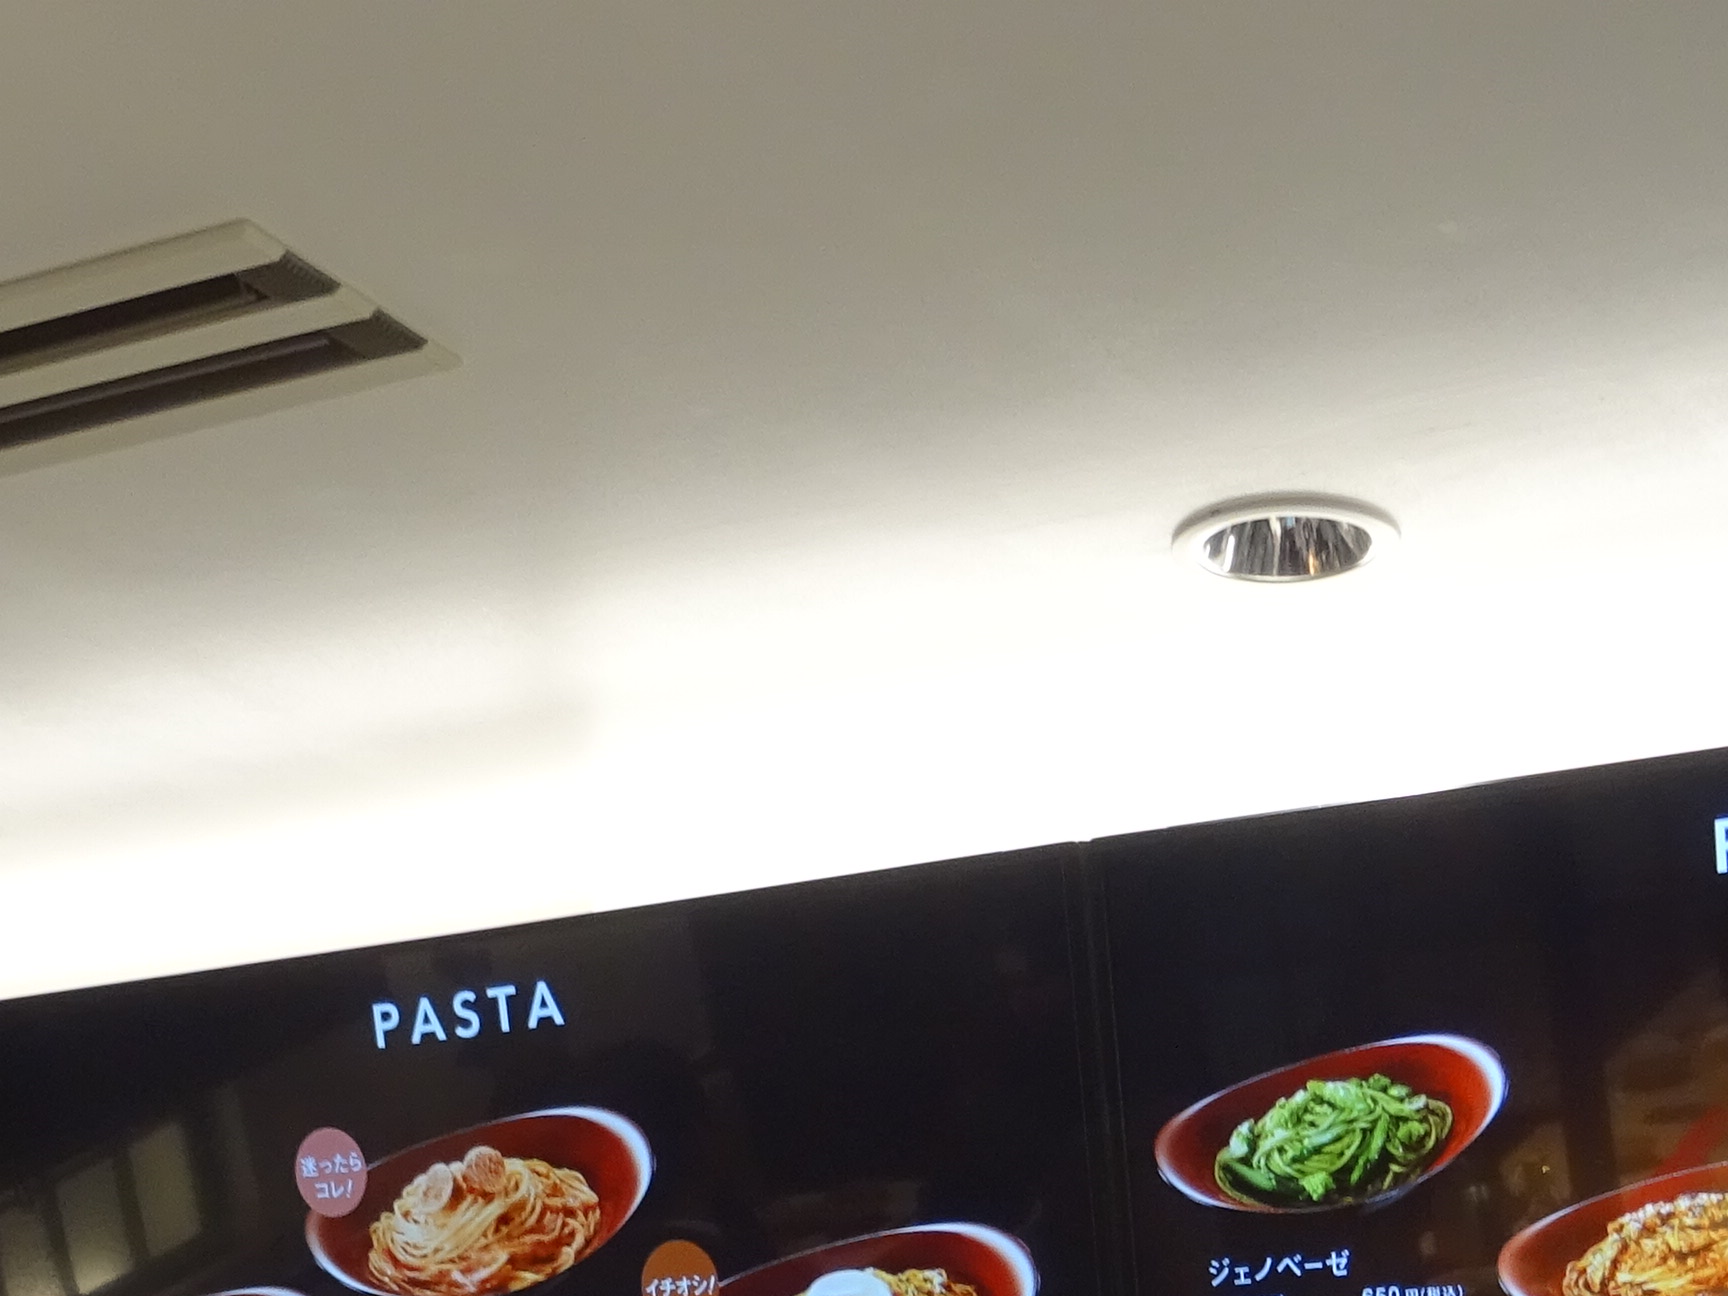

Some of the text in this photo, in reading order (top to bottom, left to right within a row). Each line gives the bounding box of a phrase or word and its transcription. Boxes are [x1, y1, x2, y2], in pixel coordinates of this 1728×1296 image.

[372, 980, 565, 1049] PASTA
[299, 1152, 363, 1179] 迷ったら
[1209, 1249, 1350, 1287] ジェノベーゼ
